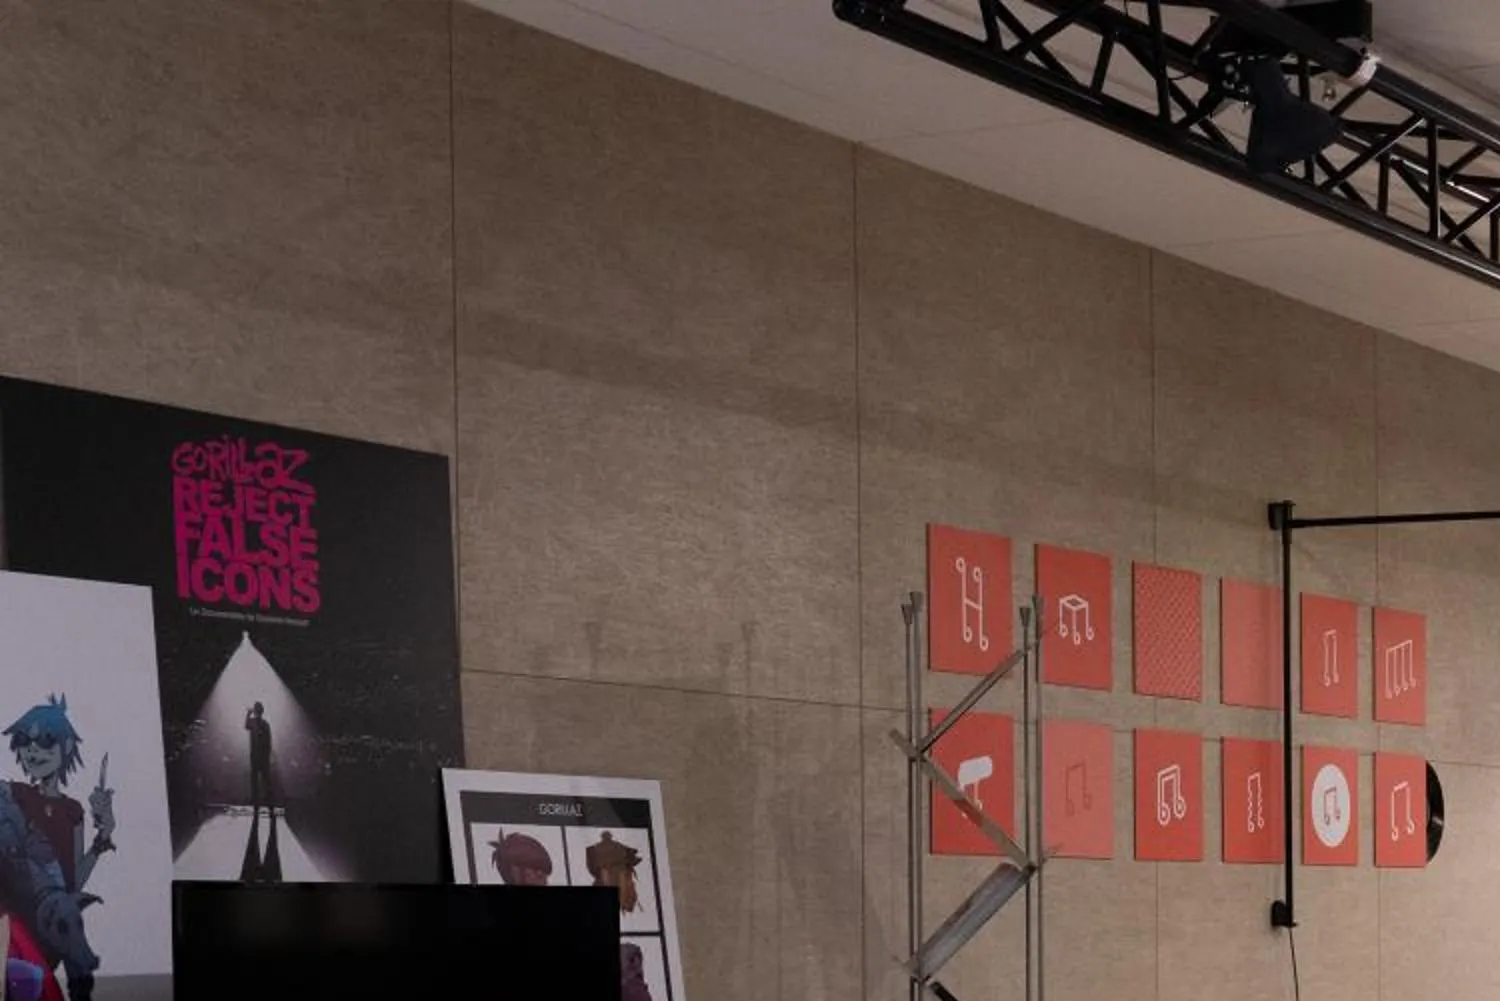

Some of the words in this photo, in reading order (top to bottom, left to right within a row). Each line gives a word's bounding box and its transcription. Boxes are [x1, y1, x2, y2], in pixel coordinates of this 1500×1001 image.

[174, 476, 316, 529] REJECT
[175, 513, 319, 571] FALSE
[177, 557, 320, 613] ICONS
